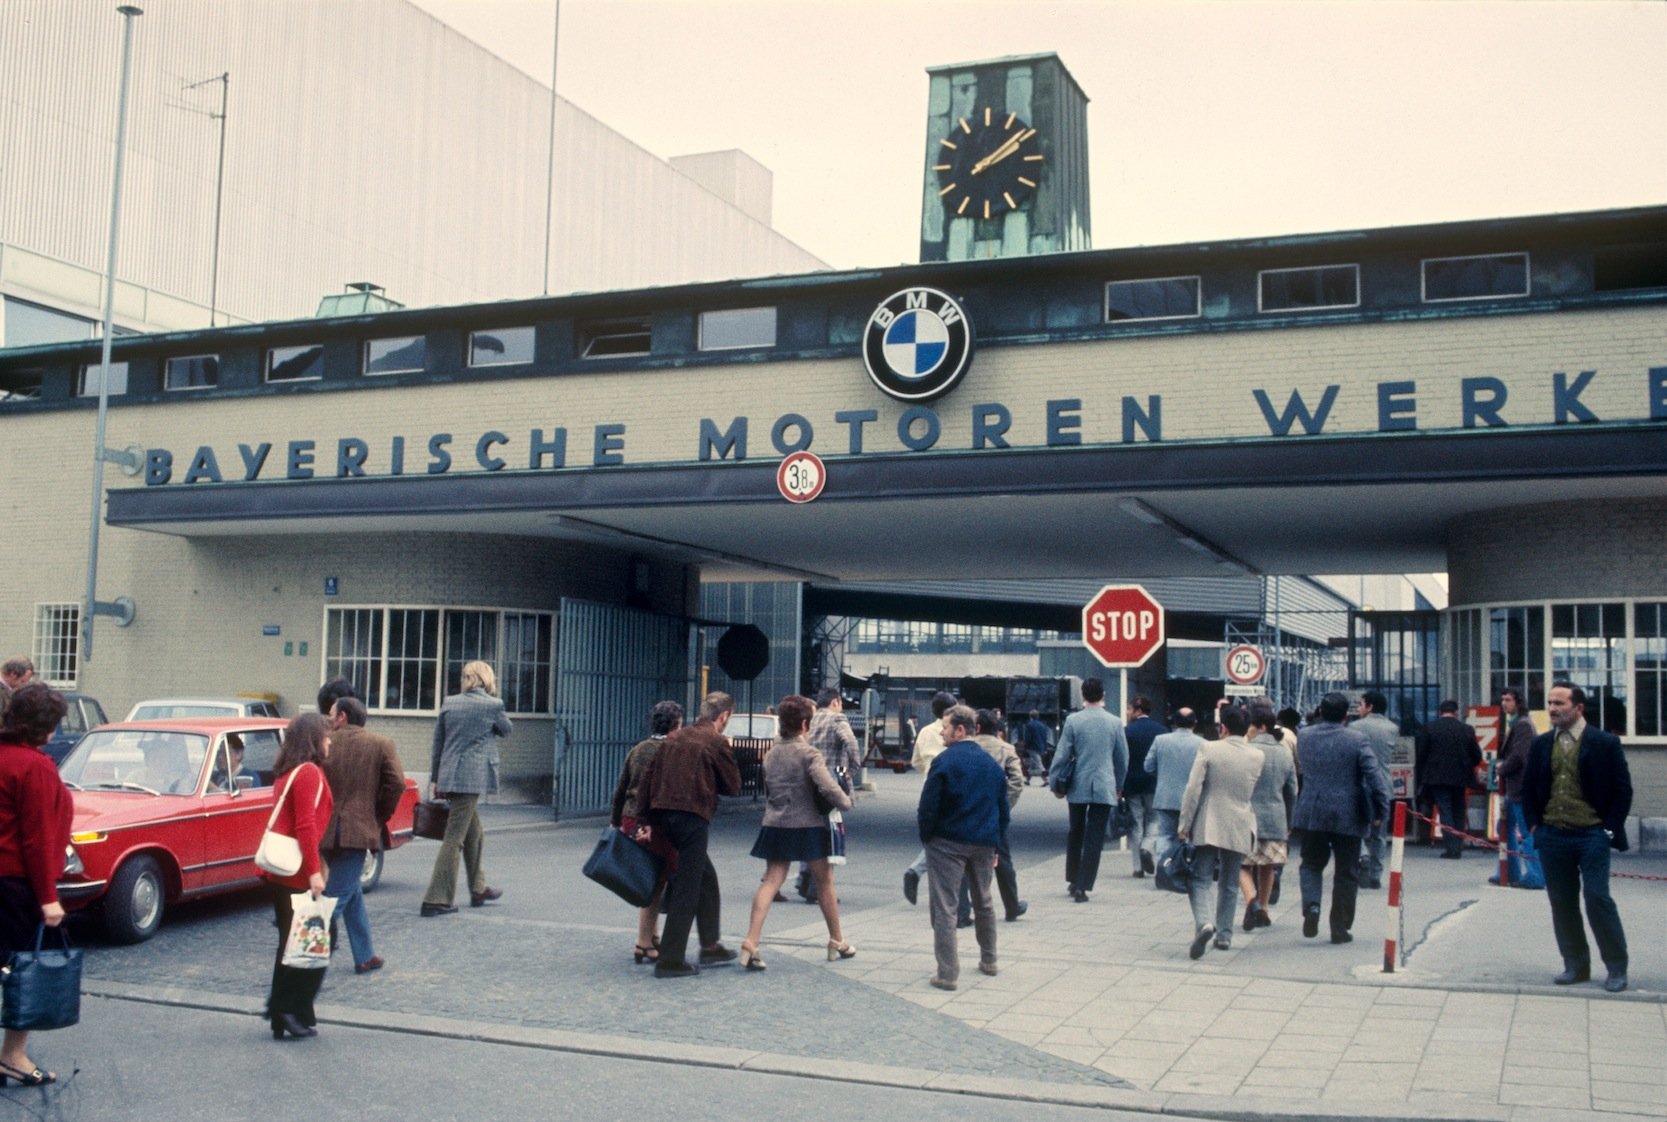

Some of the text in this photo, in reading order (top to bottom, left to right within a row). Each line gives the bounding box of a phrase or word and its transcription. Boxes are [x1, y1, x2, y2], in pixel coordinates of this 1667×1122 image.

[874, 291, 960, 328] BMW
[145, 424, 626, 486] BAYERISCHE
[700, 395, 1161, 460] MOTOREN
[1092, 610, 1154, 641] STOP
[1235, 654, 1250, 673] 25
